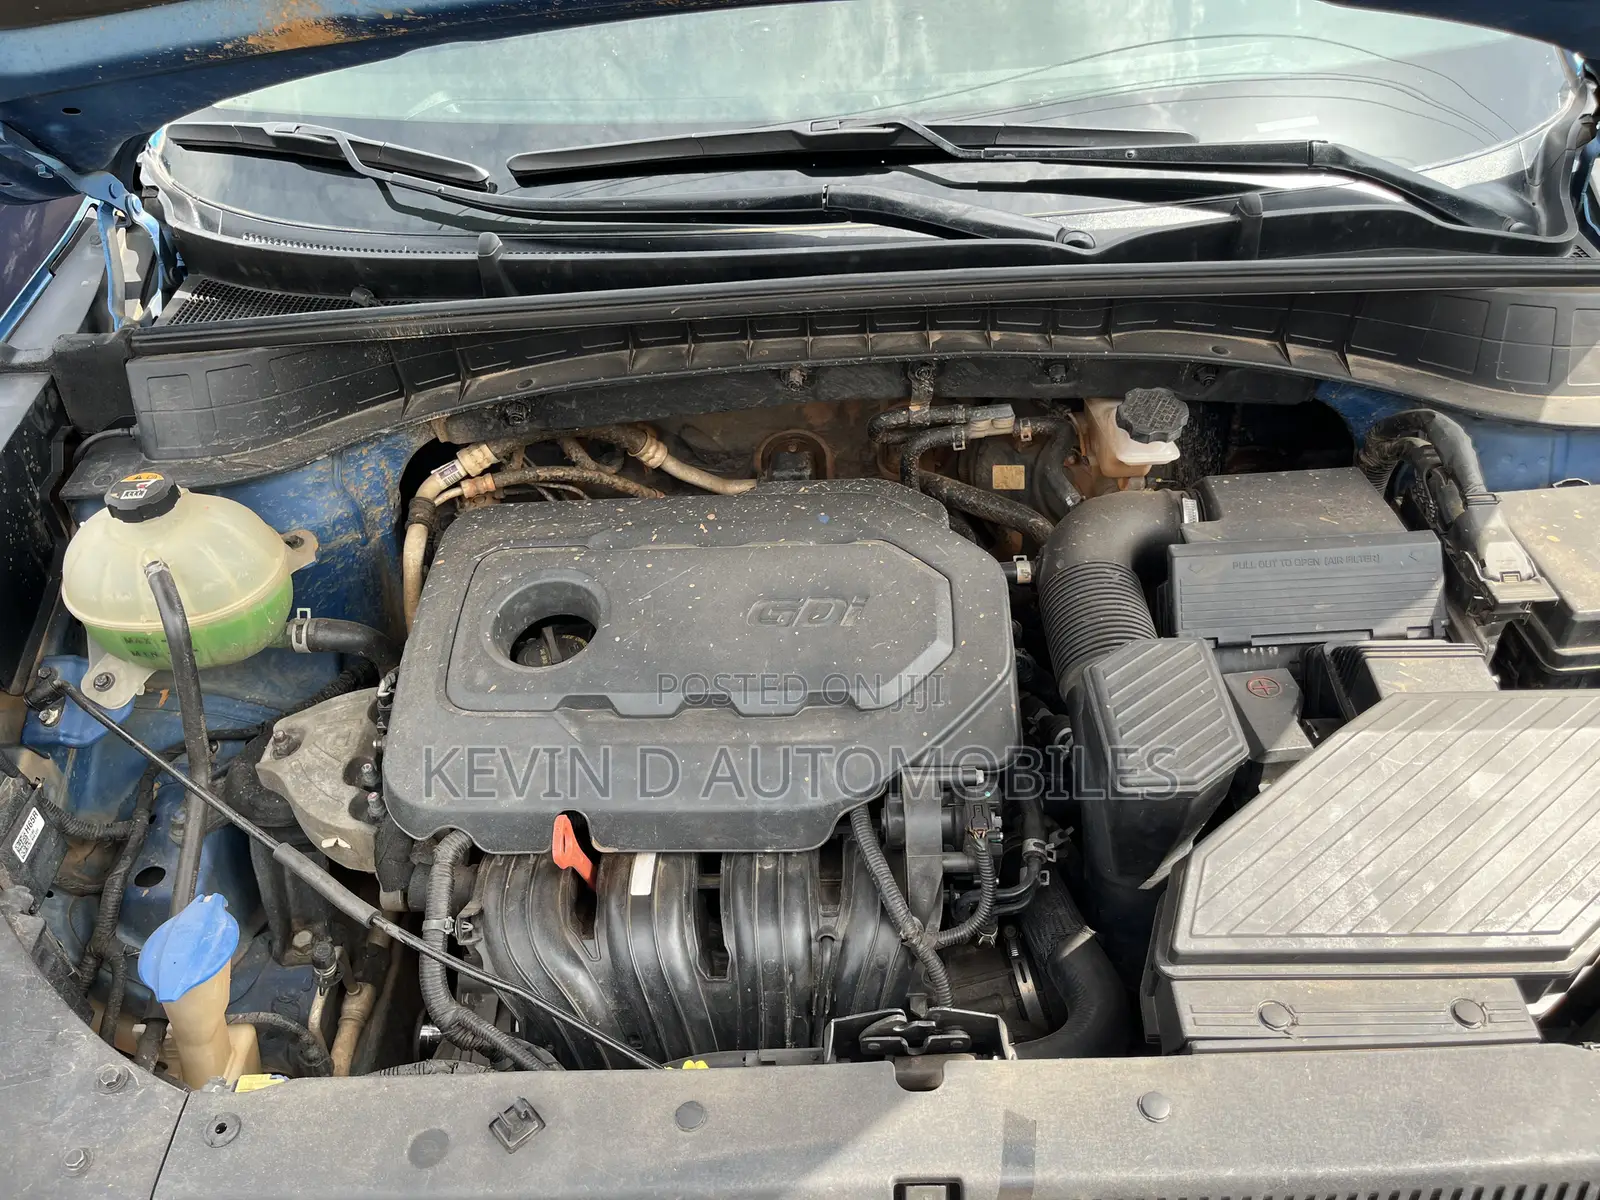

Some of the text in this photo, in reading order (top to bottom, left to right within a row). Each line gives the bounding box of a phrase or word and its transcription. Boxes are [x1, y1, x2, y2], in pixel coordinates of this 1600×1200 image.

[1232, 560, 1257, 570] PULL
[1258, 559, 1278, 569] OUT
[1279, 558, 1293, 567] TO
[1294, 557, 1321, 567] OPEN
